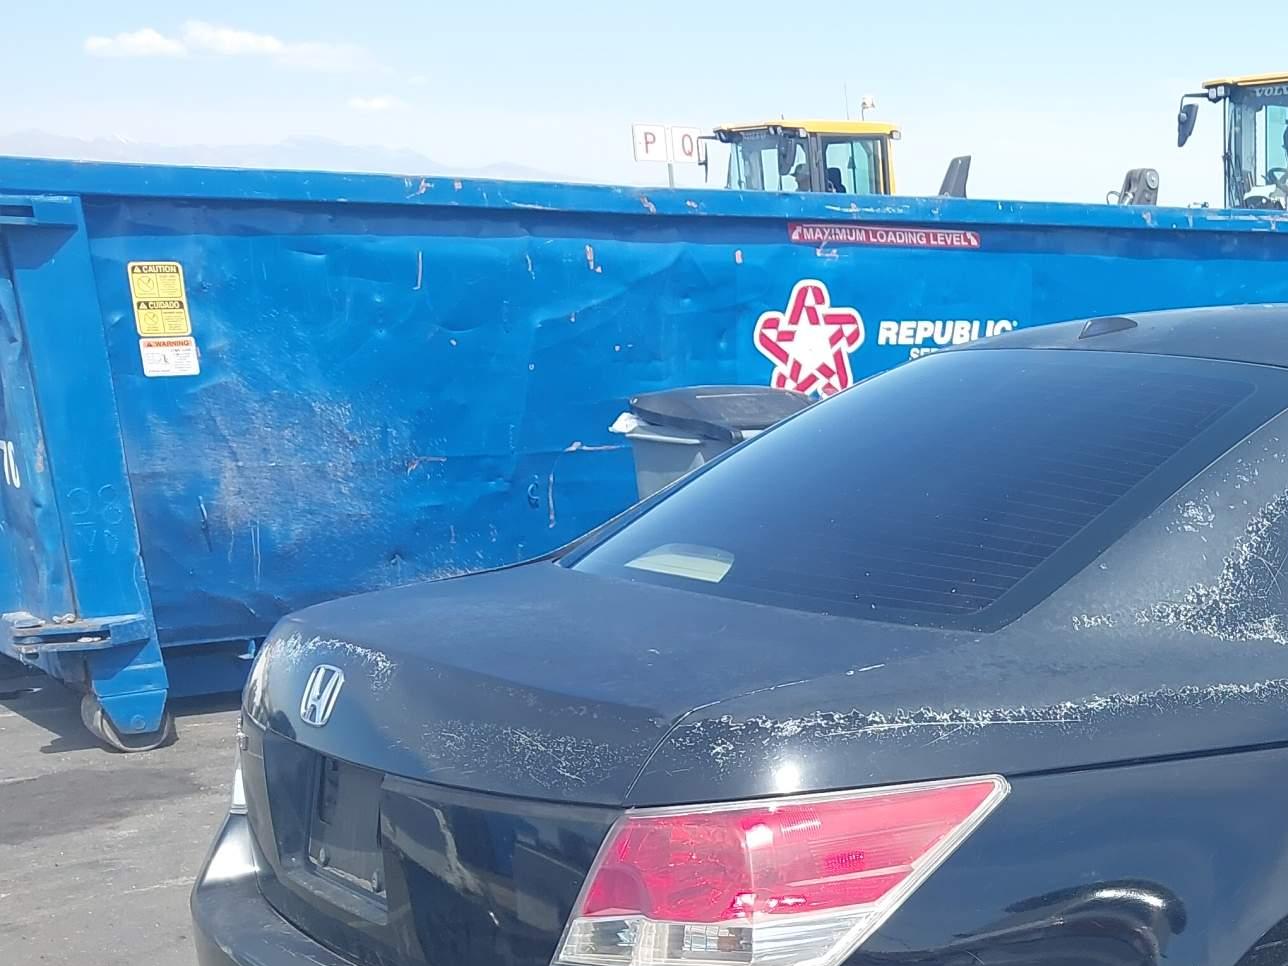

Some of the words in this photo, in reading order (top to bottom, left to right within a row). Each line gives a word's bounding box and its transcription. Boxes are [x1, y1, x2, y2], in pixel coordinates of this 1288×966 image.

[644, 132, 656, 154] P
[682, 134, 694, 157] Q
[803, 228, 865, 241] MAXIMUM
[869, 231, 927, 244] LOADING
[930, 233, 967, 246] LEVEL
[142, 265, 177, 274] CAUTION
[148, 301, 180, 310] CUIDADO
[154, 340, 190, 348] WARNING
